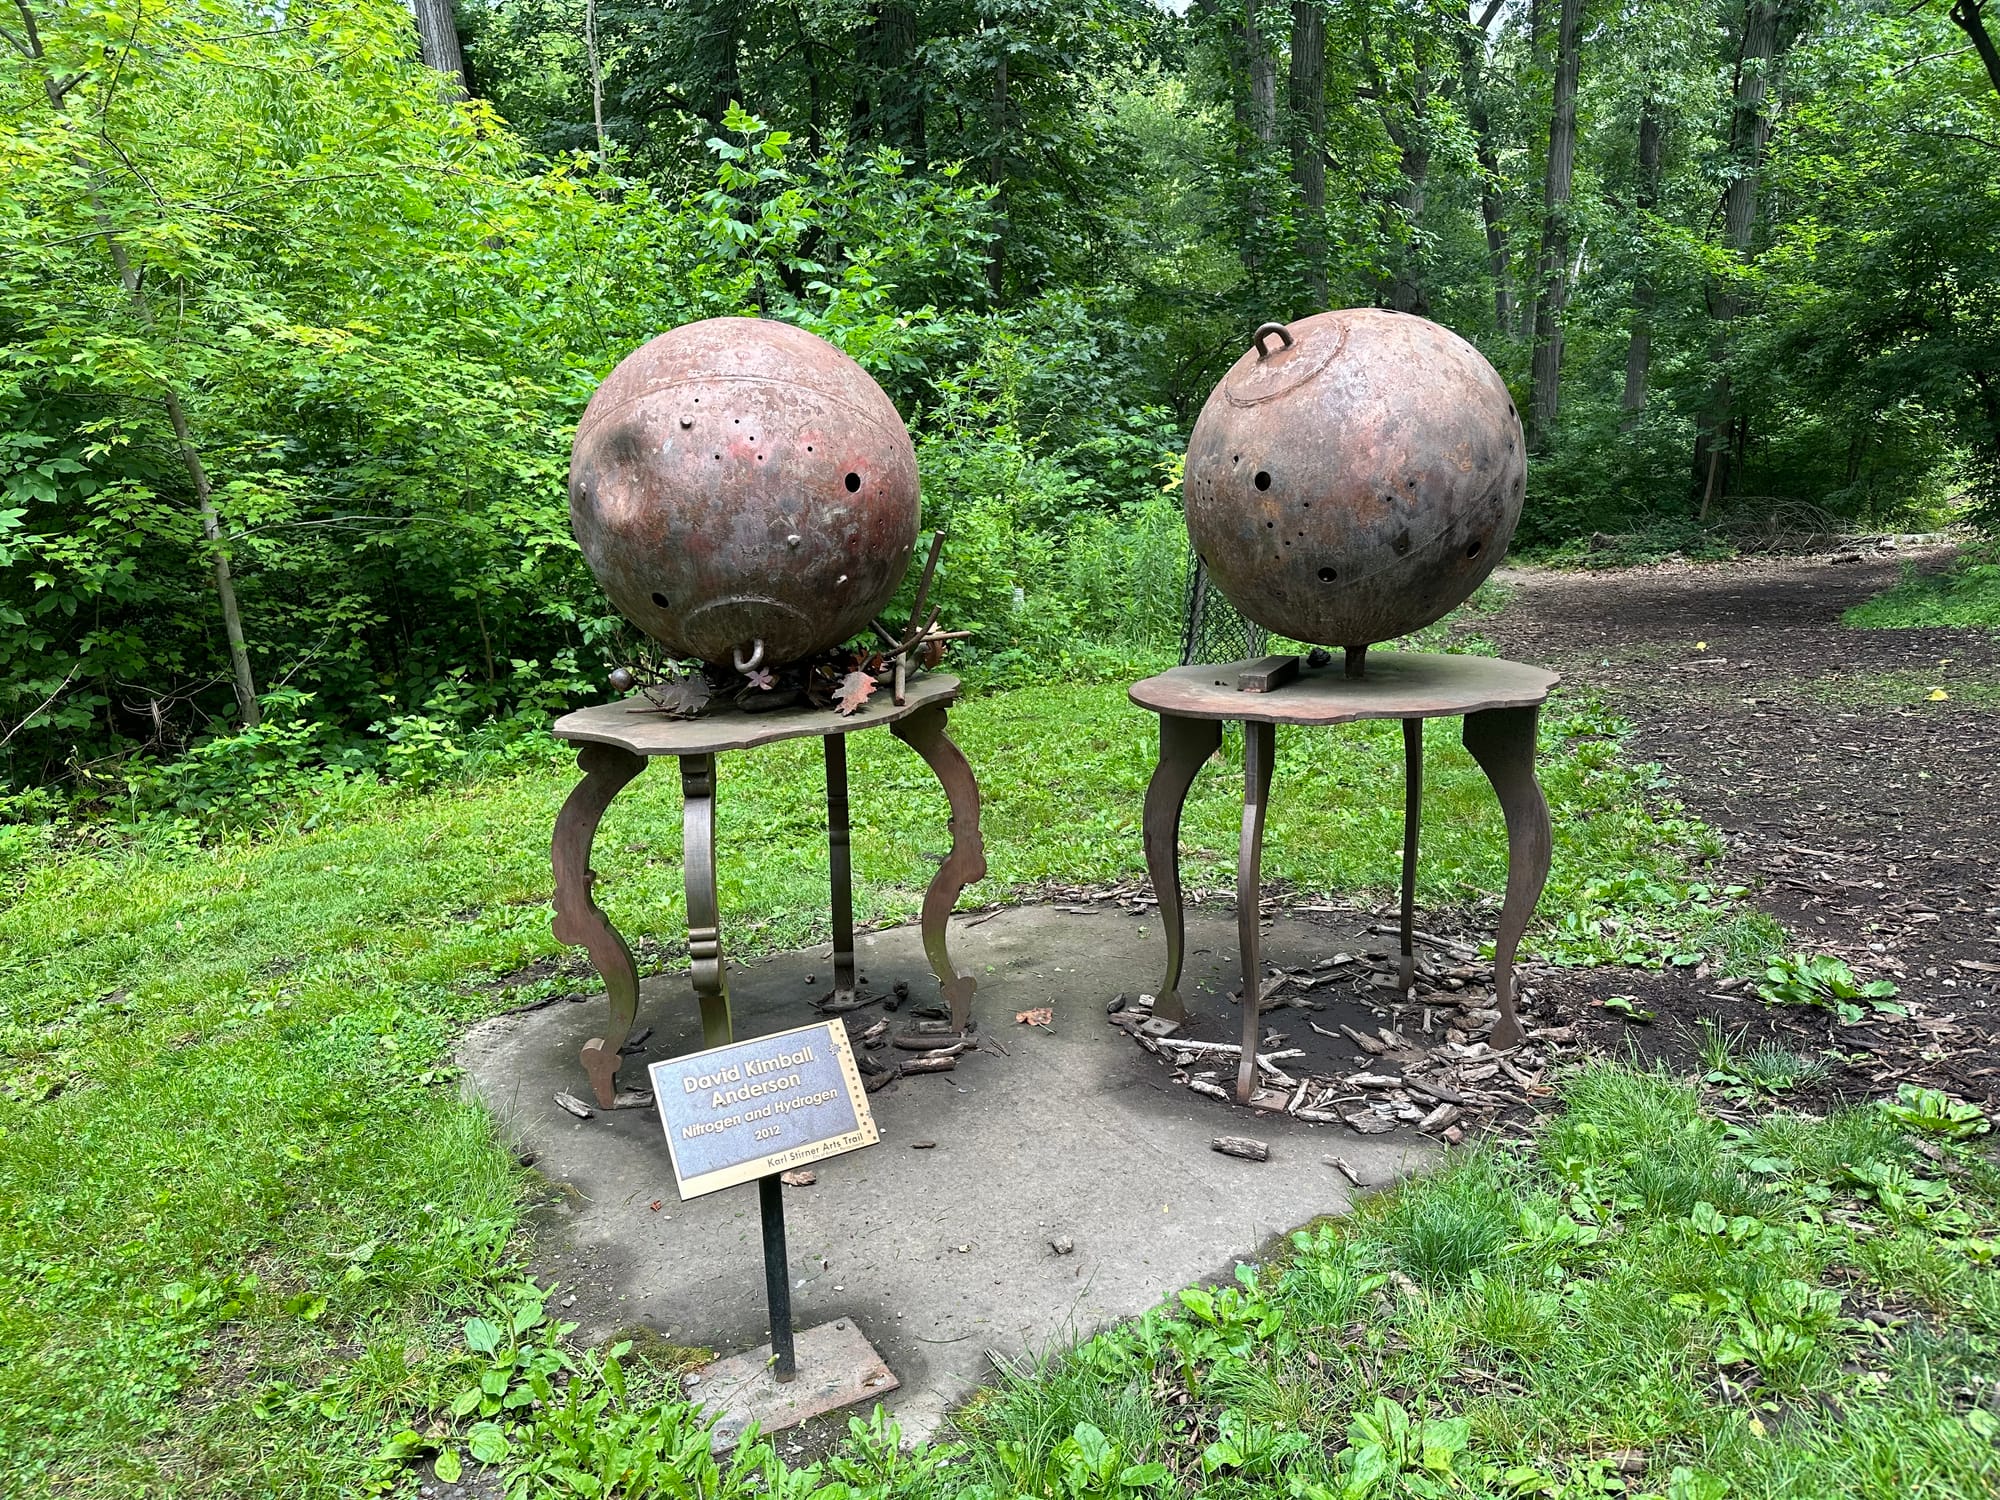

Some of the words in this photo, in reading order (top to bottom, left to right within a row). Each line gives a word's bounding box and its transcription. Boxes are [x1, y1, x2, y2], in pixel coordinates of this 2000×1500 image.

[684, 1064, 741, 1093] David
[745, 1047, 814, 1077] Kimball
[711, 1072, 802, 1108] Anderson
[682, 1115, 741, 1140] Nitrogen
[745, 1104, 771, 1122] and
[774, 1088, 838, 1115] Hydrogen
[755, 1125, 781, 1142] 2012
[767, 1157, 788, 1168] Karl
[789, 1147, 820, 1161] Stirner
[822, 1141, 842, 1152] Arts
[842, 1133, 864, 1145] Trail
